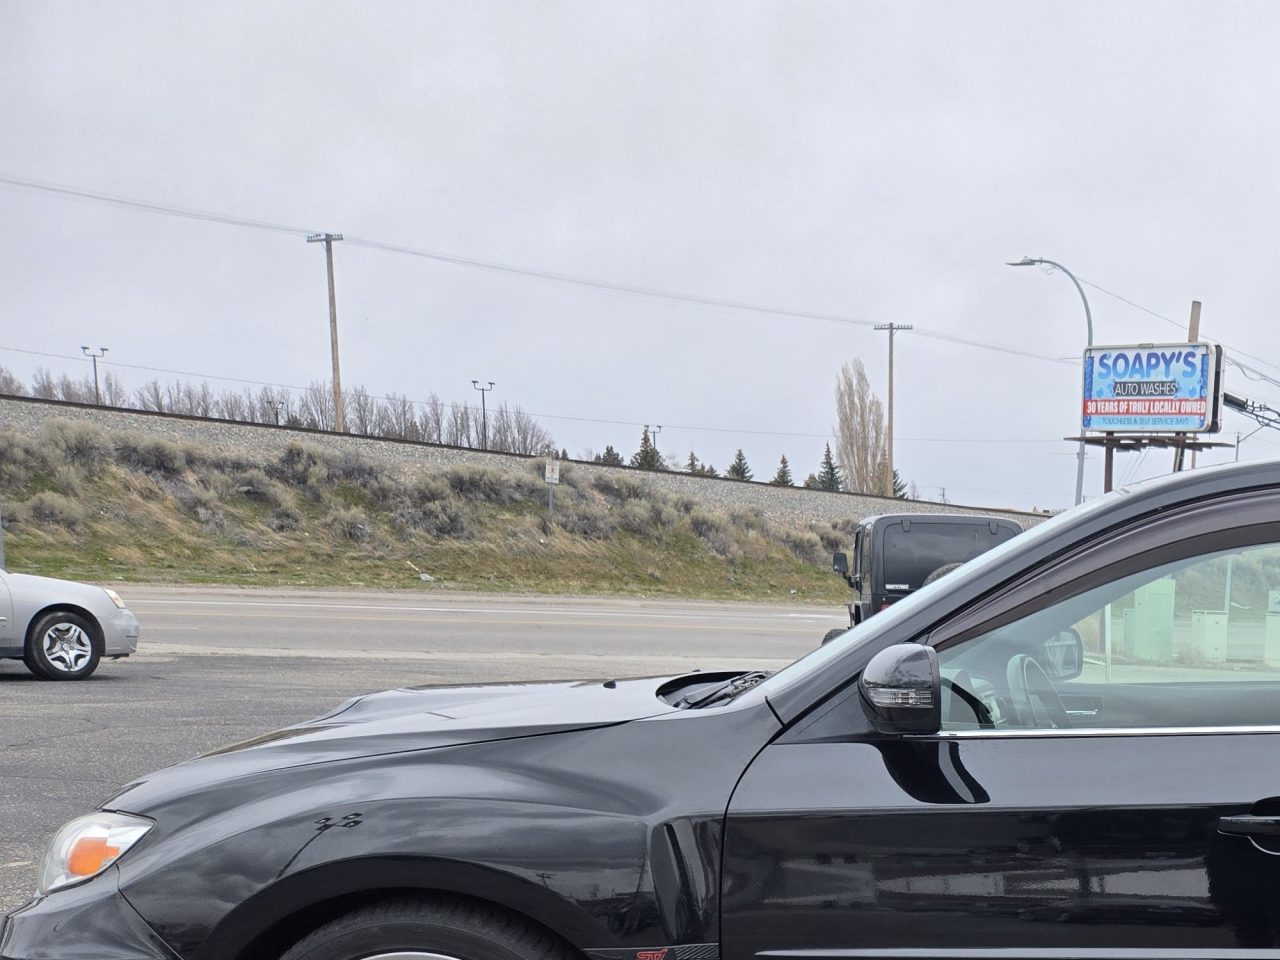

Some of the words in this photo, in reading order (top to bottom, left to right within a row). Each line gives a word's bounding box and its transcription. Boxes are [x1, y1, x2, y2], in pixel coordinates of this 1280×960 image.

[1098, 351, 1197, 379] SOAPY'S
[1115, 382, 1139, 396] AUTO
[1140, 381, 1177, 396] WASHES
[1087, 401, 1096, 413] 30
[1097, 401, 1118, 413] YEARS
[1119, 401, 1128, 413] OF
[1129, 401, 1151, 413] TRULY
[1151, 401, 1181, 413] LOCALLY
[1181, 401, 1206, 413] OWNED
[1102, 417, 1133, 425] TOUCHLESS
[1139, 417, 1151, 425] SELF
[1151, 417, 1175, 425] SERVICE
[1175, 417, 1189, 425] BAYS
